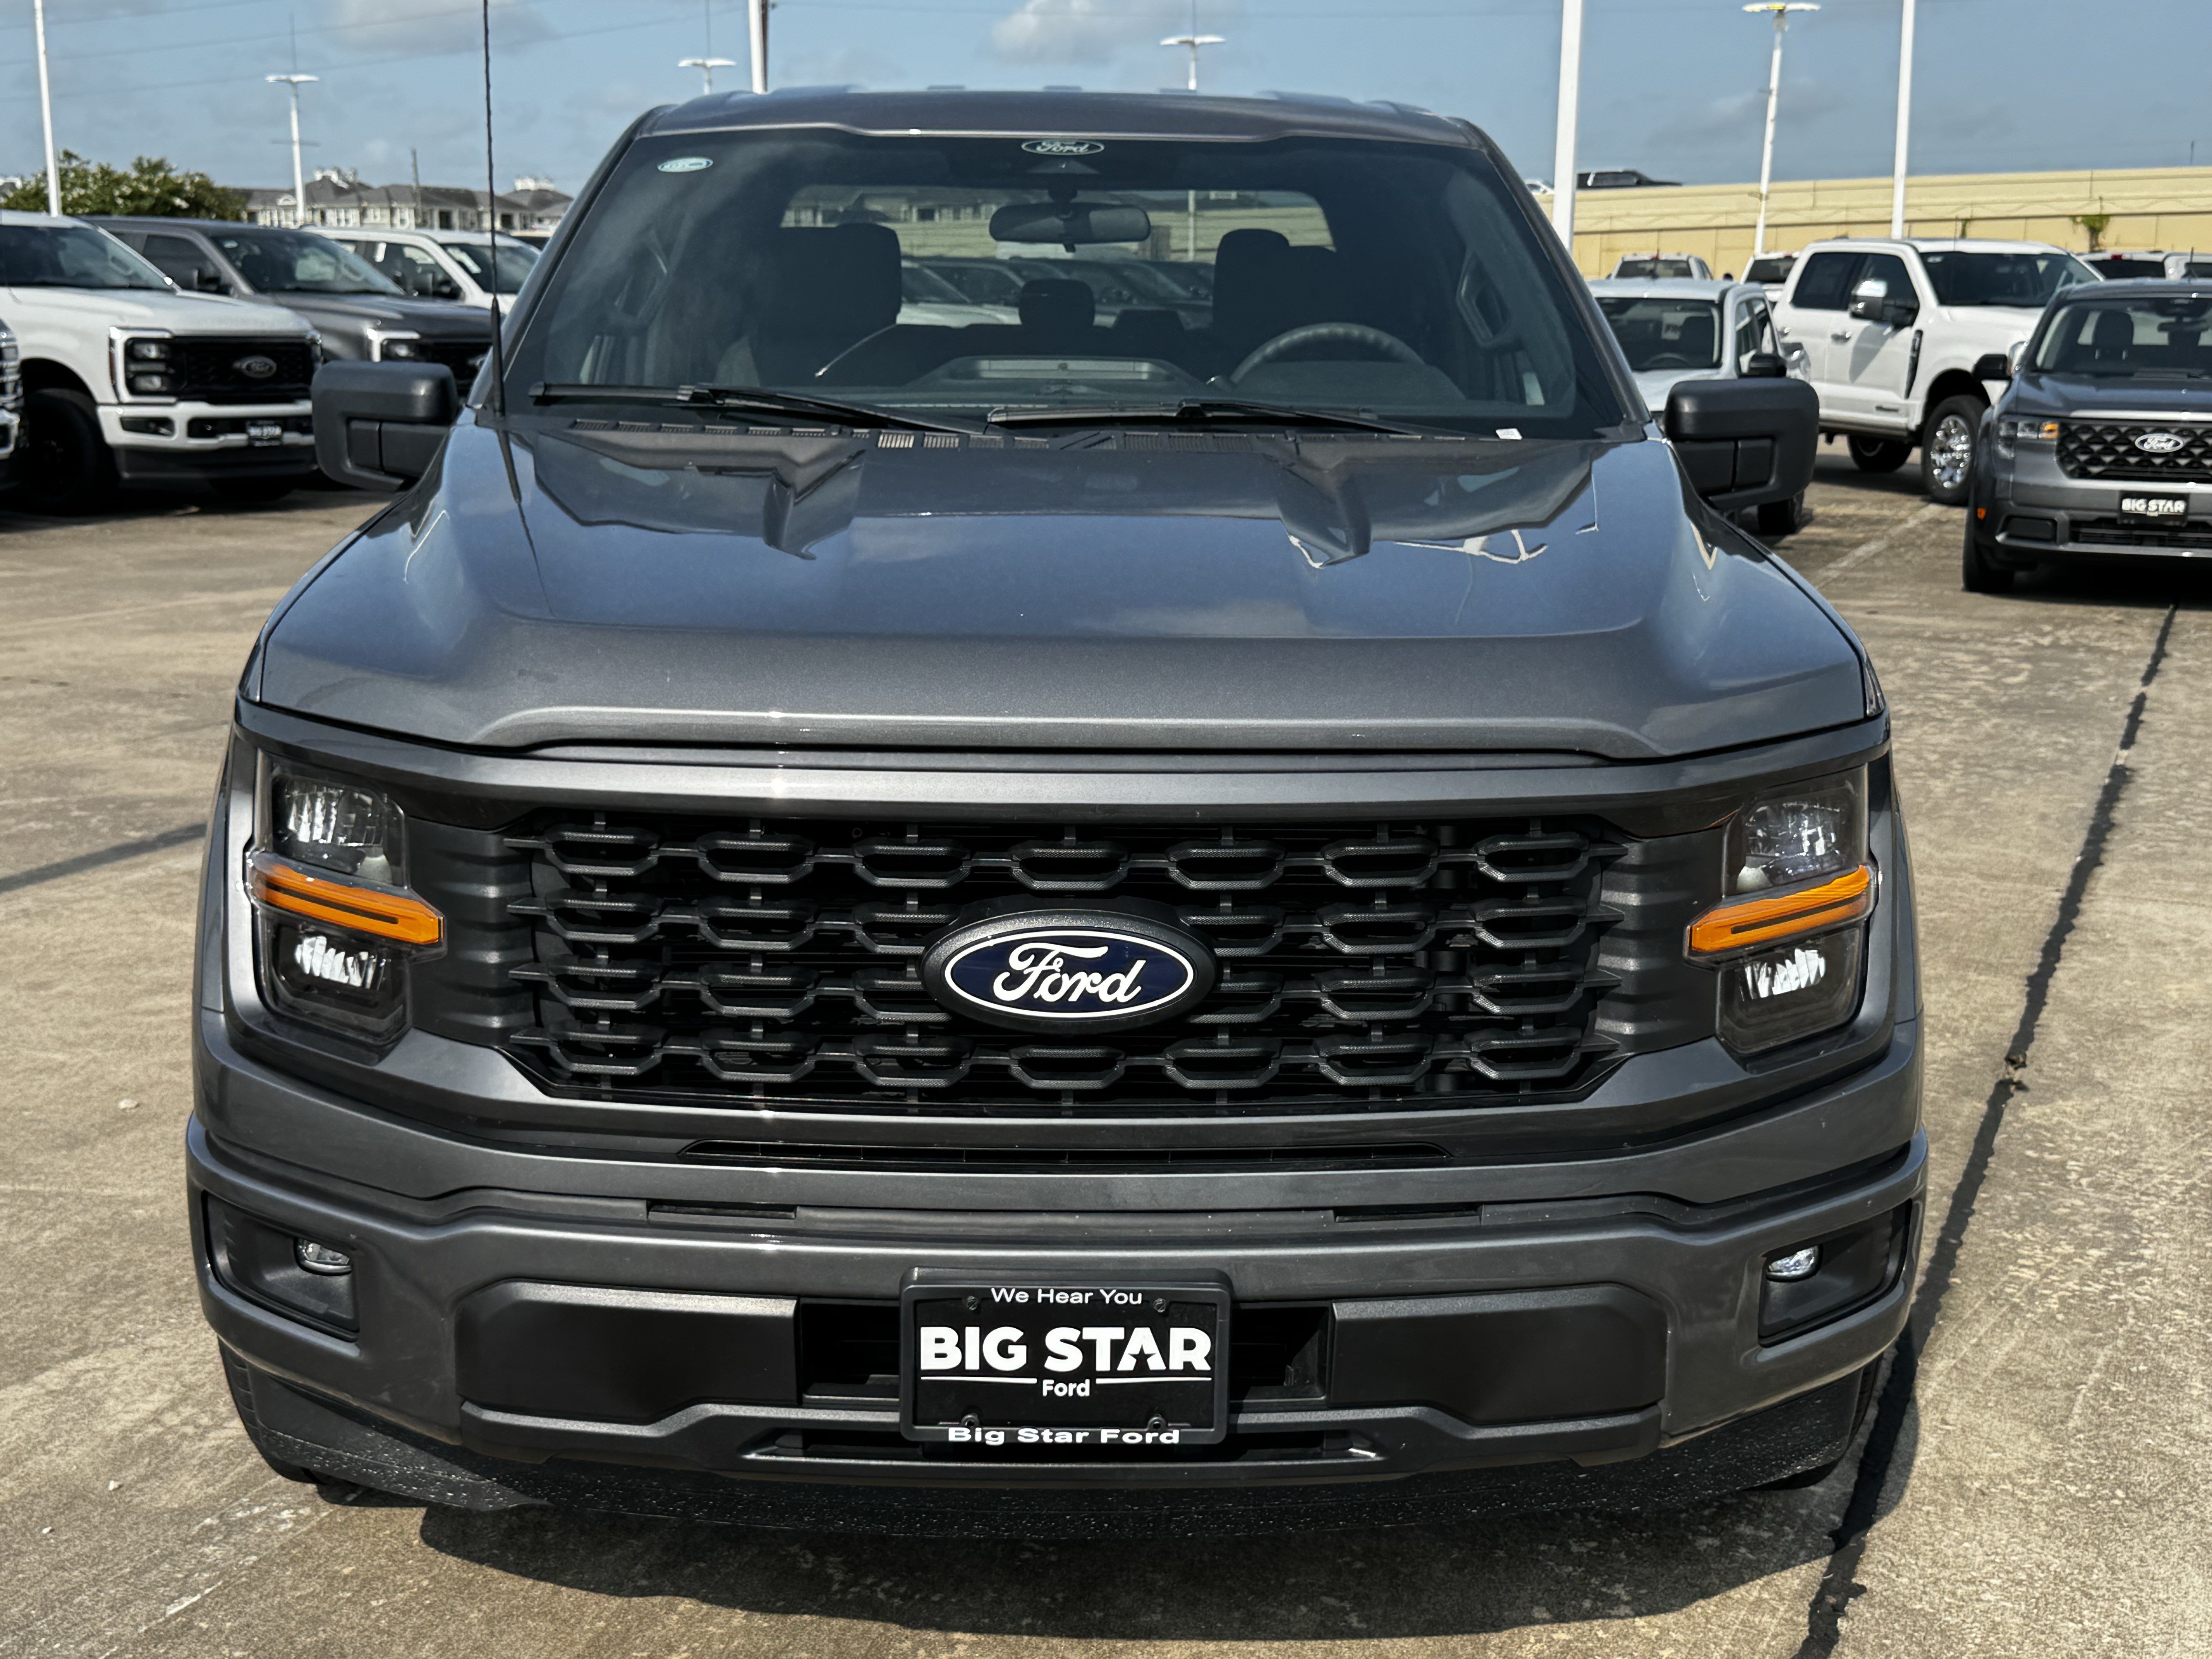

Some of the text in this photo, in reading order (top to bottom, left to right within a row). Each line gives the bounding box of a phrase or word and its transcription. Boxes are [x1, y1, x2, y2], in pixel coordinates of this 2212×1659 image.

[1036, 140, 1090, 153] Ford
[2143, 436, 2174, 450] Ford
[2122, 498, 2186, 513] BIG STAR
[993, 942, 1146, 1003] Ford
[991, 1288, 1142, 1304] We Hear You
[921, 1326, 1211, 1372] BIG STAR
[1042, 1379, 1090, 1396] Ford
[948, 1427, 1180, 1446] Big Star Ford
